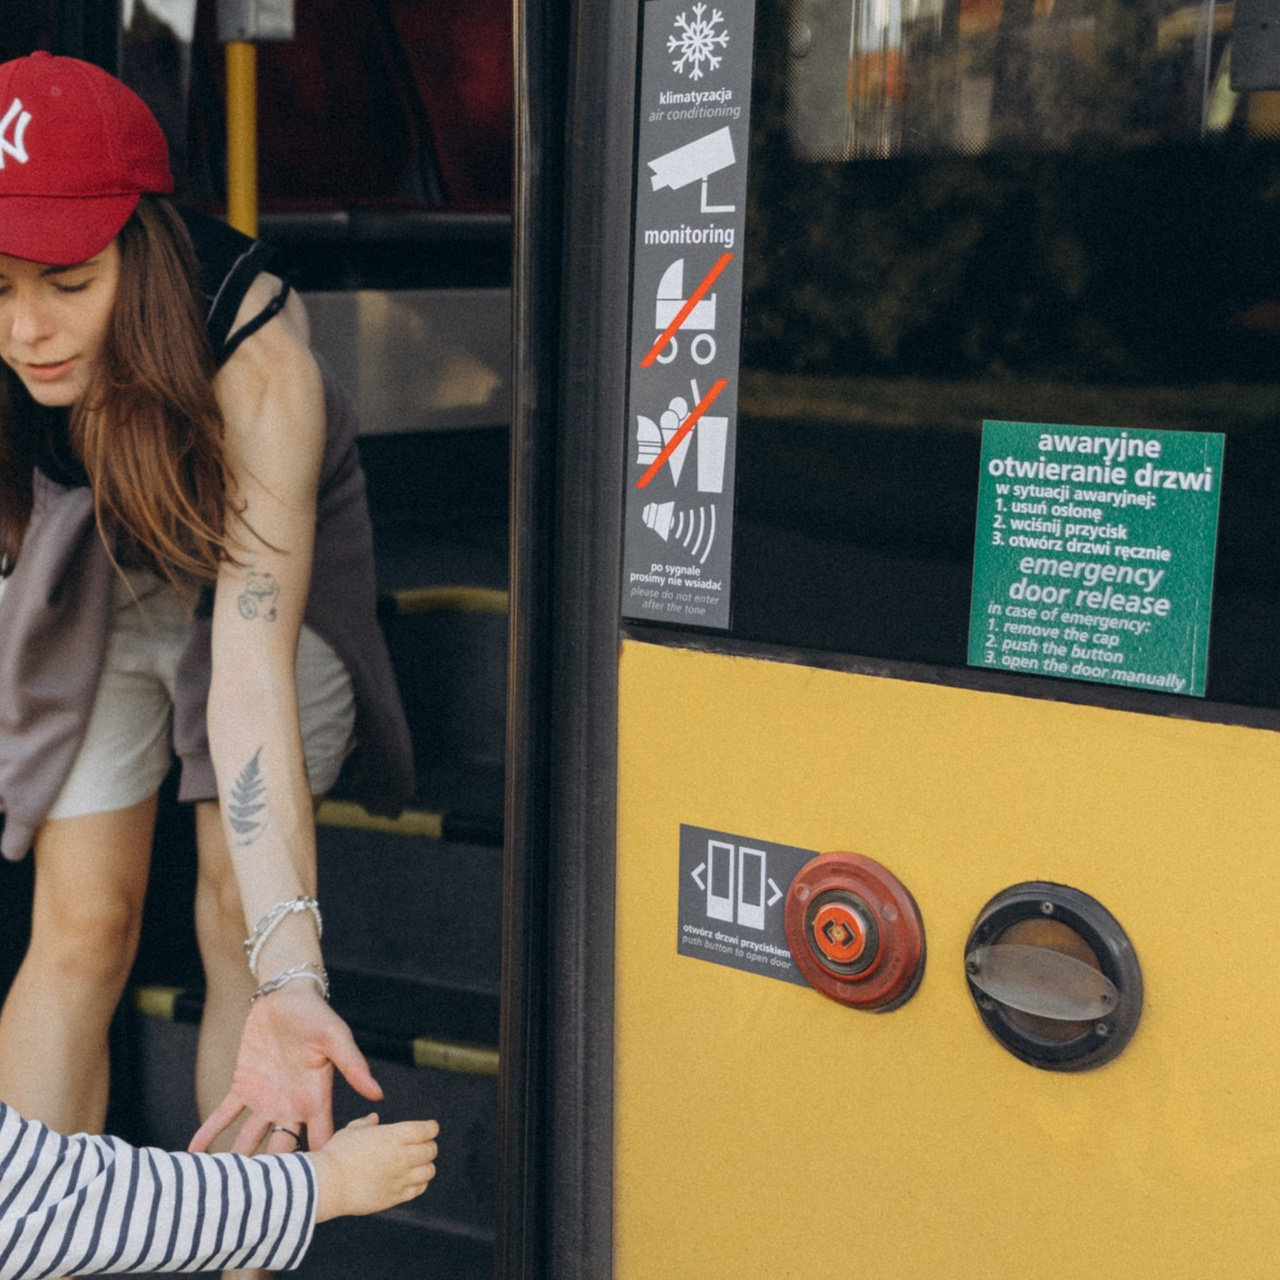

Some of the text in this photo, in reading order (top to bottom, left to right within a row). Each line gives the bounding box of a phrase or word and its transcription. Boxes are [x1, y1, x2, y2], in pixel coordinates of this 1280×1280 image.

[660, 87, 732, 106] klimatyzacja
[649, 104, 741, 122] air conditioning
[645, 223, 735, 249] monitoring
[1038, 432, 1161, 462] awaryjne
[988, 456, 1212, 492] otwieranie drzwi
[995, 498, 1102, 523] 1. usuń osłonę
[996, 483, 1156, 510] w sytuacji awaryjnej:
[993, 515, 1127, 541] 2. wciśnij przycisk
[992, 531, 1171, 562] 3. otwórz drzwi ręcznie
[630, 573, 722, 591] prosimy nie wsiadać
[651, 563, 701, 578] po sygnale
[1019, 556, 1164, 592] emergency
[630, 586, 719, 605] please do not enter
[642, 599, 706, 615] after the tone
[1009, 577, 1170, 616] door release
[988, 601, 1151, 634] in case of emergency:
[988, 618, 1120, 648] 1. remove the cap
[985, 634, 1124, 663] 2. push the button
[984, 650, 1186, 692] 3. open the door manually
[682, 935, 792, 970] push button to open door
[683, 924, 791, 959] otwórz drzwi przyciskiem
